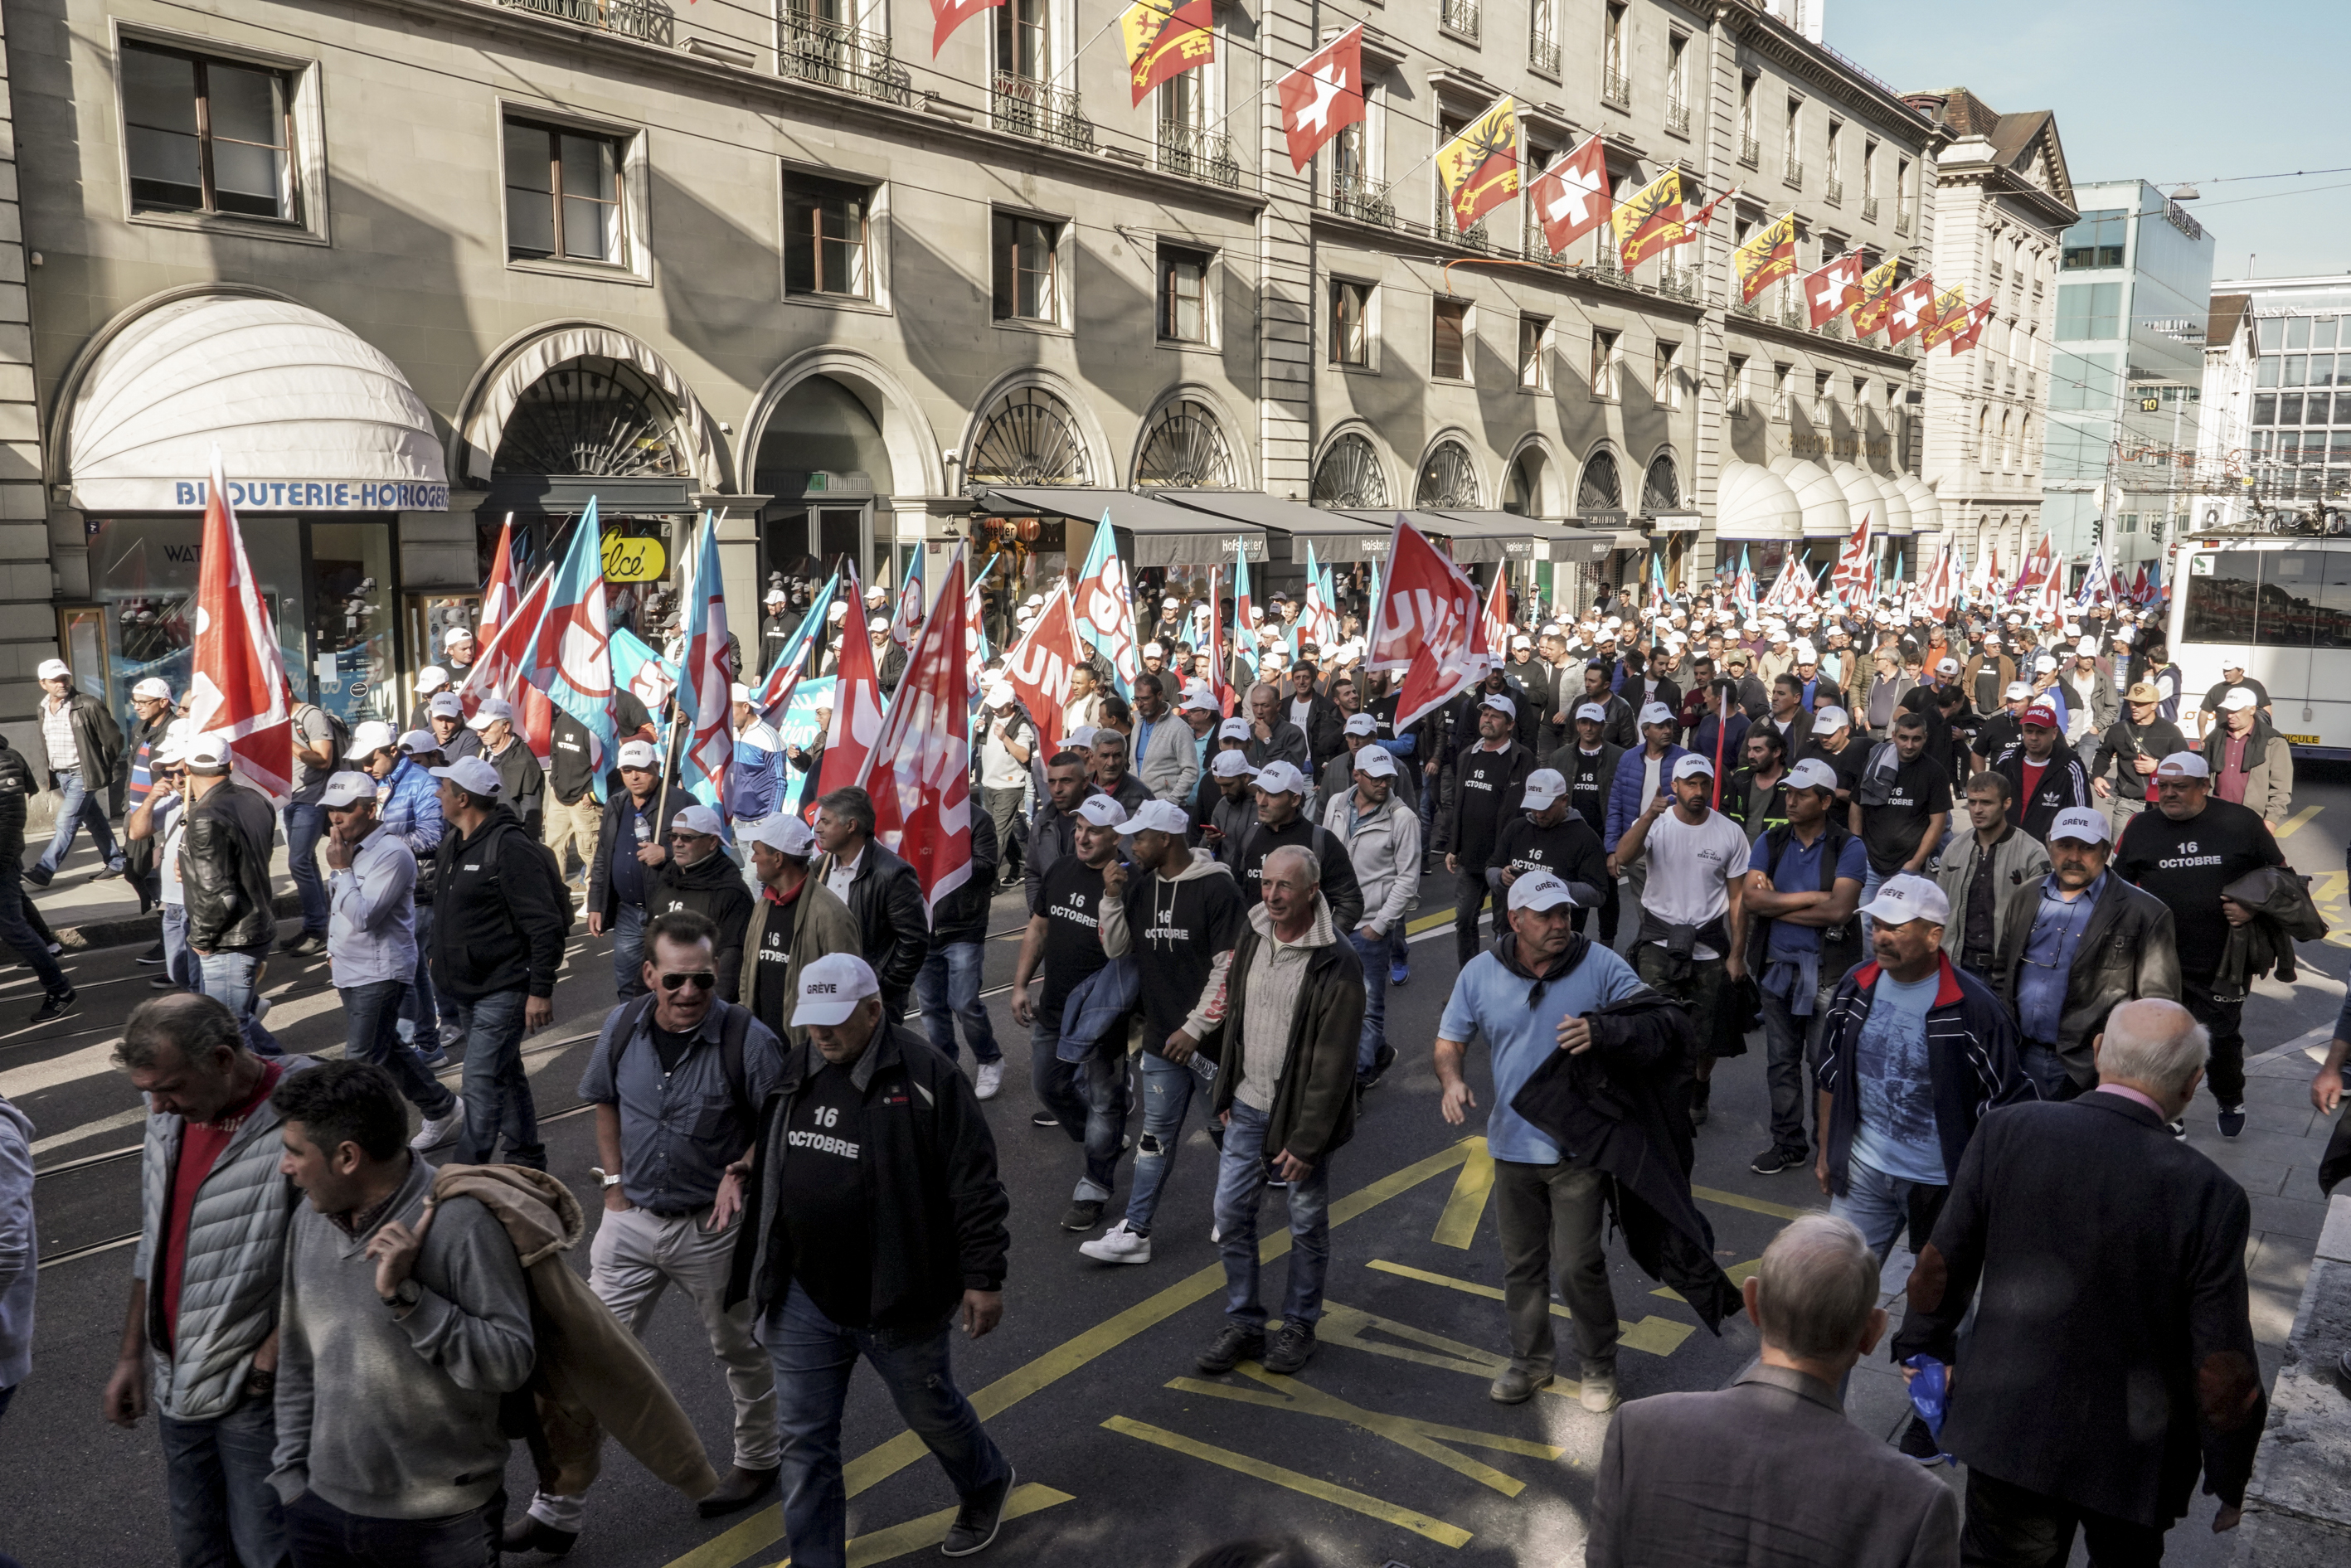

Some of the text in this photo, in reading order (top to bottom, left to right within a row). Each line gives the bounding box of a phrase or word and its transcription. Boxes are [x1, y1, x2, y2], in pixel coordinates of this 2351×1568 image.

[2142, 399, 2157, 410] 10
[1222, 540, 1262, 551] Hofsetter
[1474, 769, 1484, 779] 16
[1581, 773, 1593, 781] 16
[2062, 817, 2088, 827] GRÈVE
[1528, 848, 1542, 860] 16
[2178, 841, 2198, 855] 16
[1512, 859, 1553, 874] OCTOBRE
[2159, 855, 2222, 868] OCTOBRE
[1535, 881, 1560, 891] GRÈVE
[1070, 892, 1086, 907] 16
[668, 901, 683, 912] 16
[1051, 905, 1098, 928] OCTOBRE
[1158, 910, 1171, 924] 16
[1144, 928, 1188, 940] OCTOBRE
[806, 983, 837, 994] GRÈVE
[814, 1105, 839, 1128] 16
[788, 1130, 860, 1159] OCTOBRE
